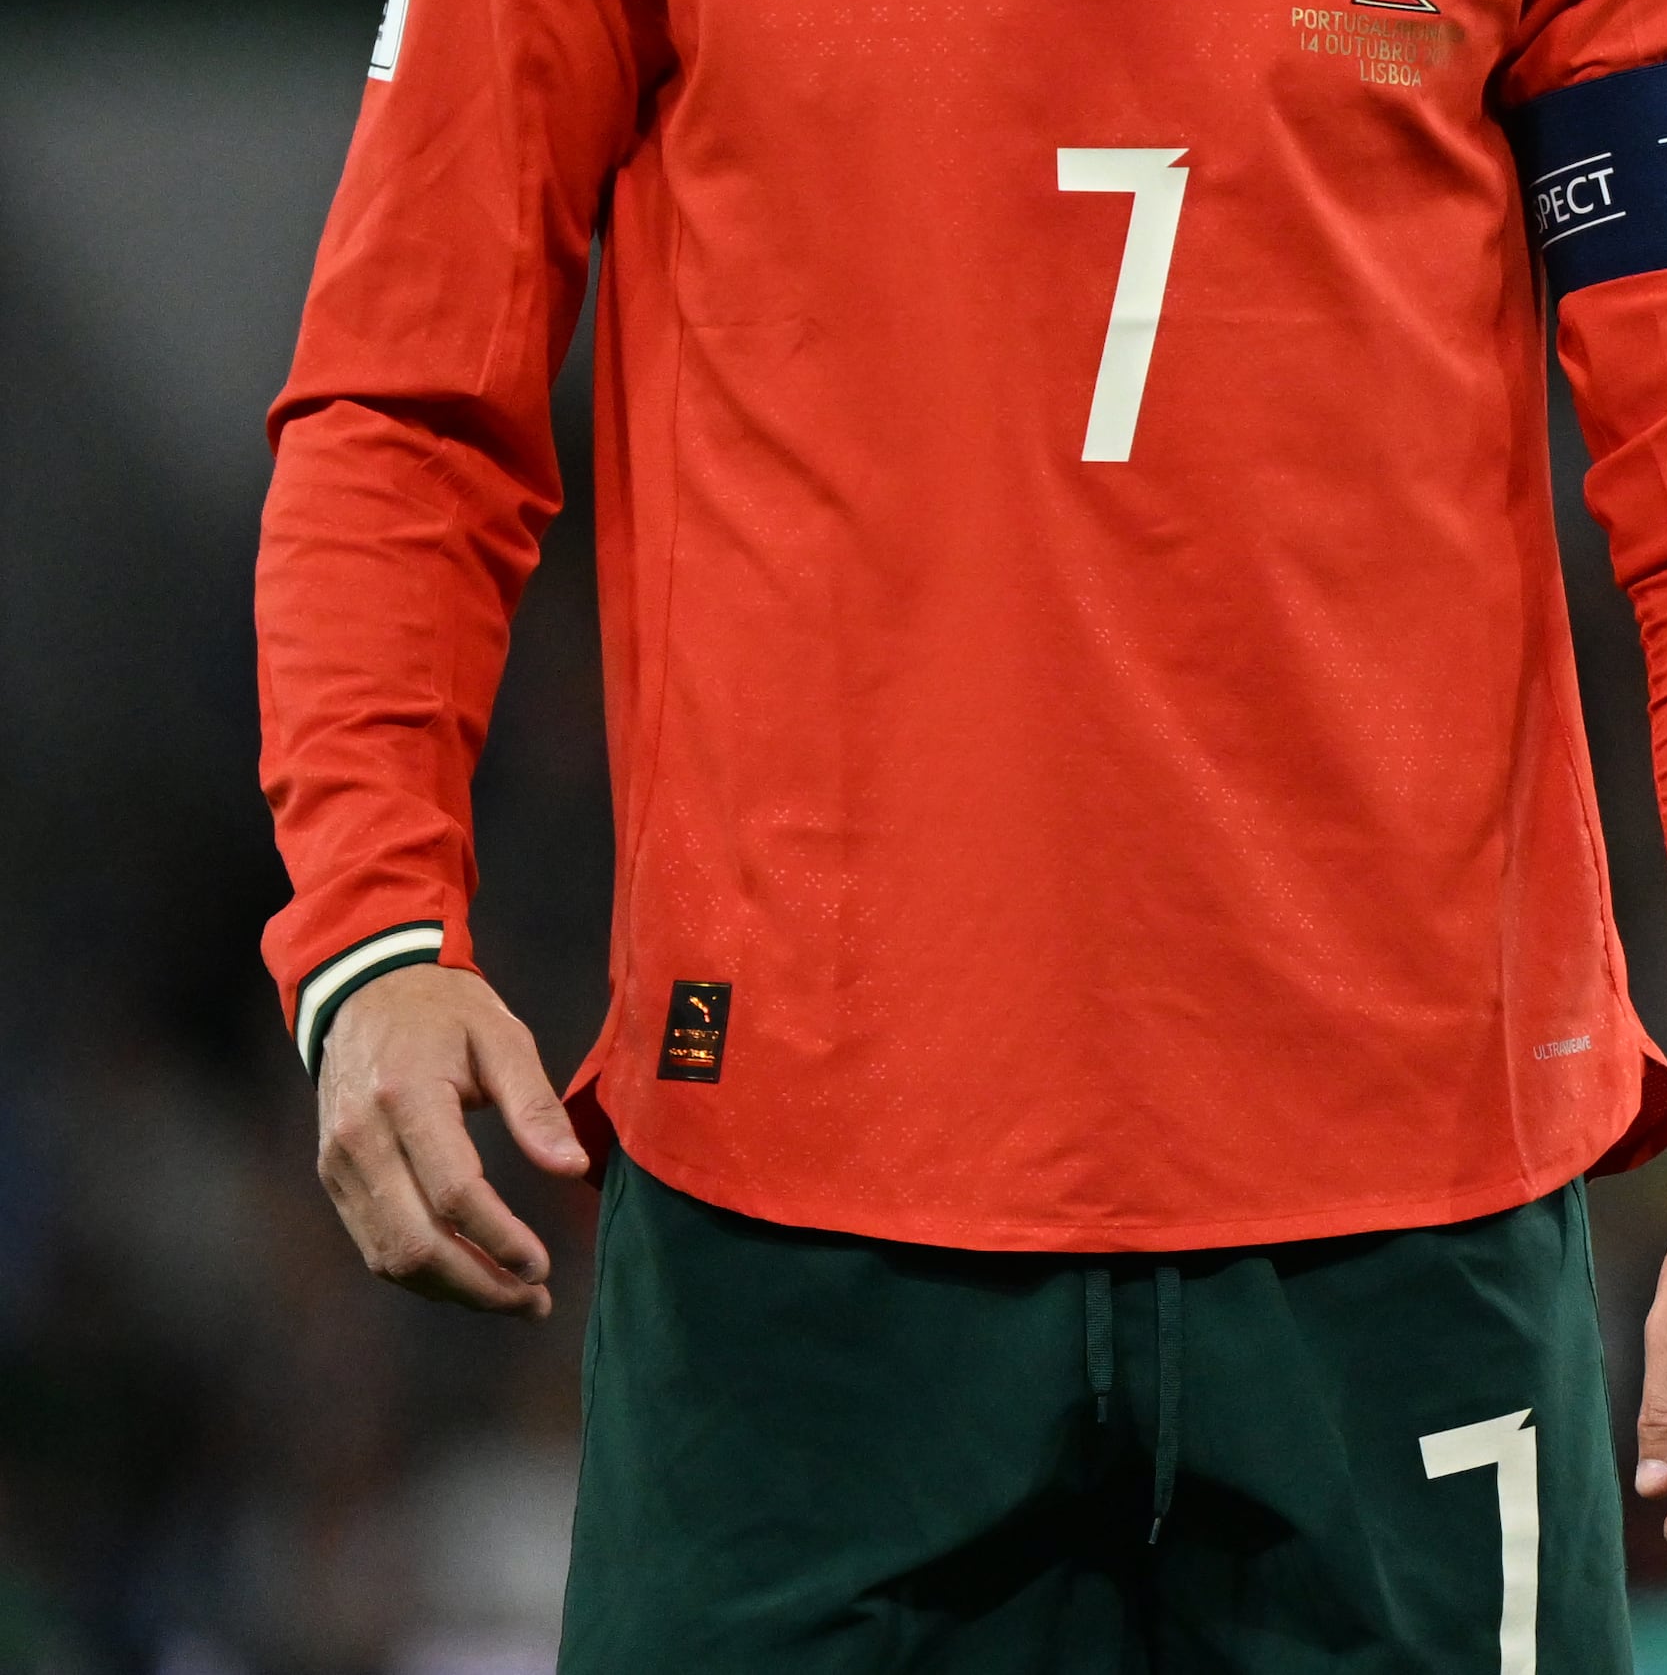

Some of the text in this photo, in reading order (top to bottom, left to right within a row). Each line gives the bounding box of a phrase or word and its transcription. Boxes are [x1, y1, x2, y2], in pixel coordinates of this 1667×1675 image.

[1291, 7, 1391, 38] PORTUGAL
[1301, 32, 1319, 53] 14
[1326, 34, 1418, 63] OUTUBRO
[1359, 59, 1422, 87] LISBOA
[1057, 148, 1190, 461] 7
[1533, 1035, 1592, 1060] ULTRAWEAVE
[1419, 1407, 1540, 1675] 7
